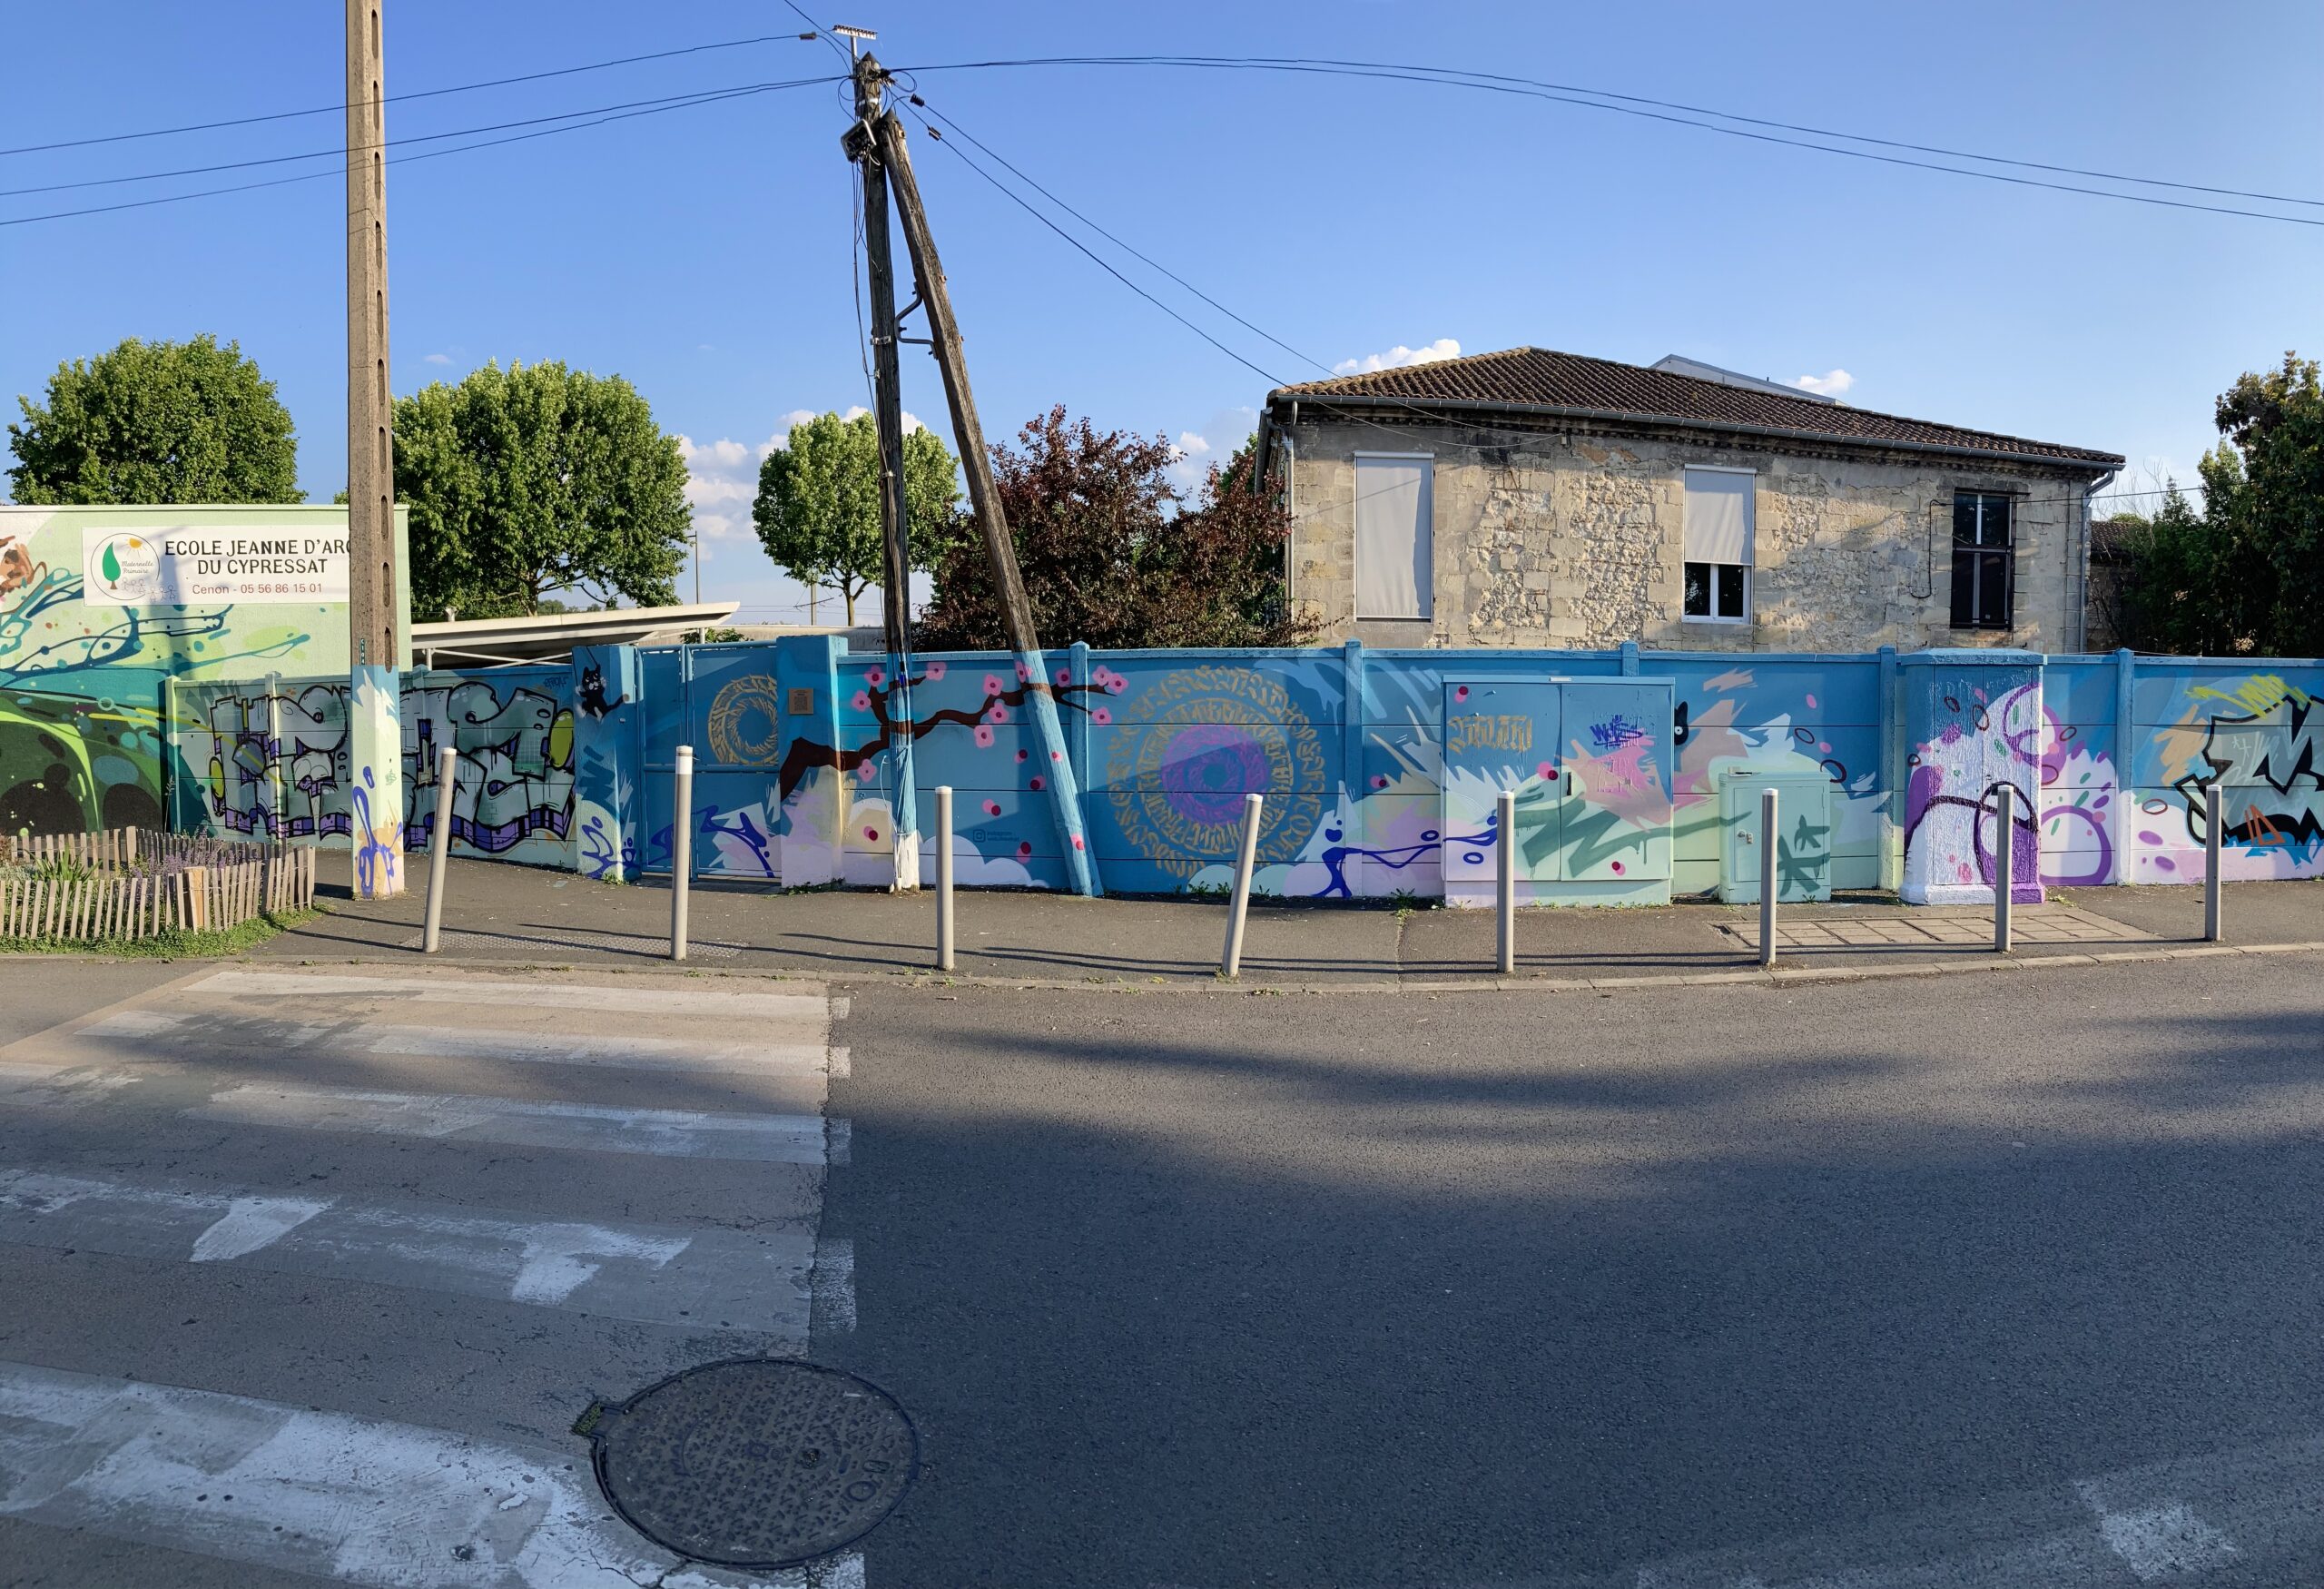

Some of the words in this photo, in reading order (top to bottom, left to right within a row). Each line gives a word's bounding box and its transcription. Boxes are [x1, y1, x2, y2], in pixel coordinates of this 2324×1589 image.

[164, 540, 222, 556] ECOLE
[226, 540, 299, 557] JEANNE
[198, 559, 222, 575] DU
[227, 558, 328, 575] CYPRESSAT
[192, 584, 230, 595] Cenon
[240, 583, 255, 594] 05
[258, 583, 272, 594] 56
[275, 583, 290, 594] 86
[293, 583, 306, 594] 15
[309, 583, 322, 594] 01
